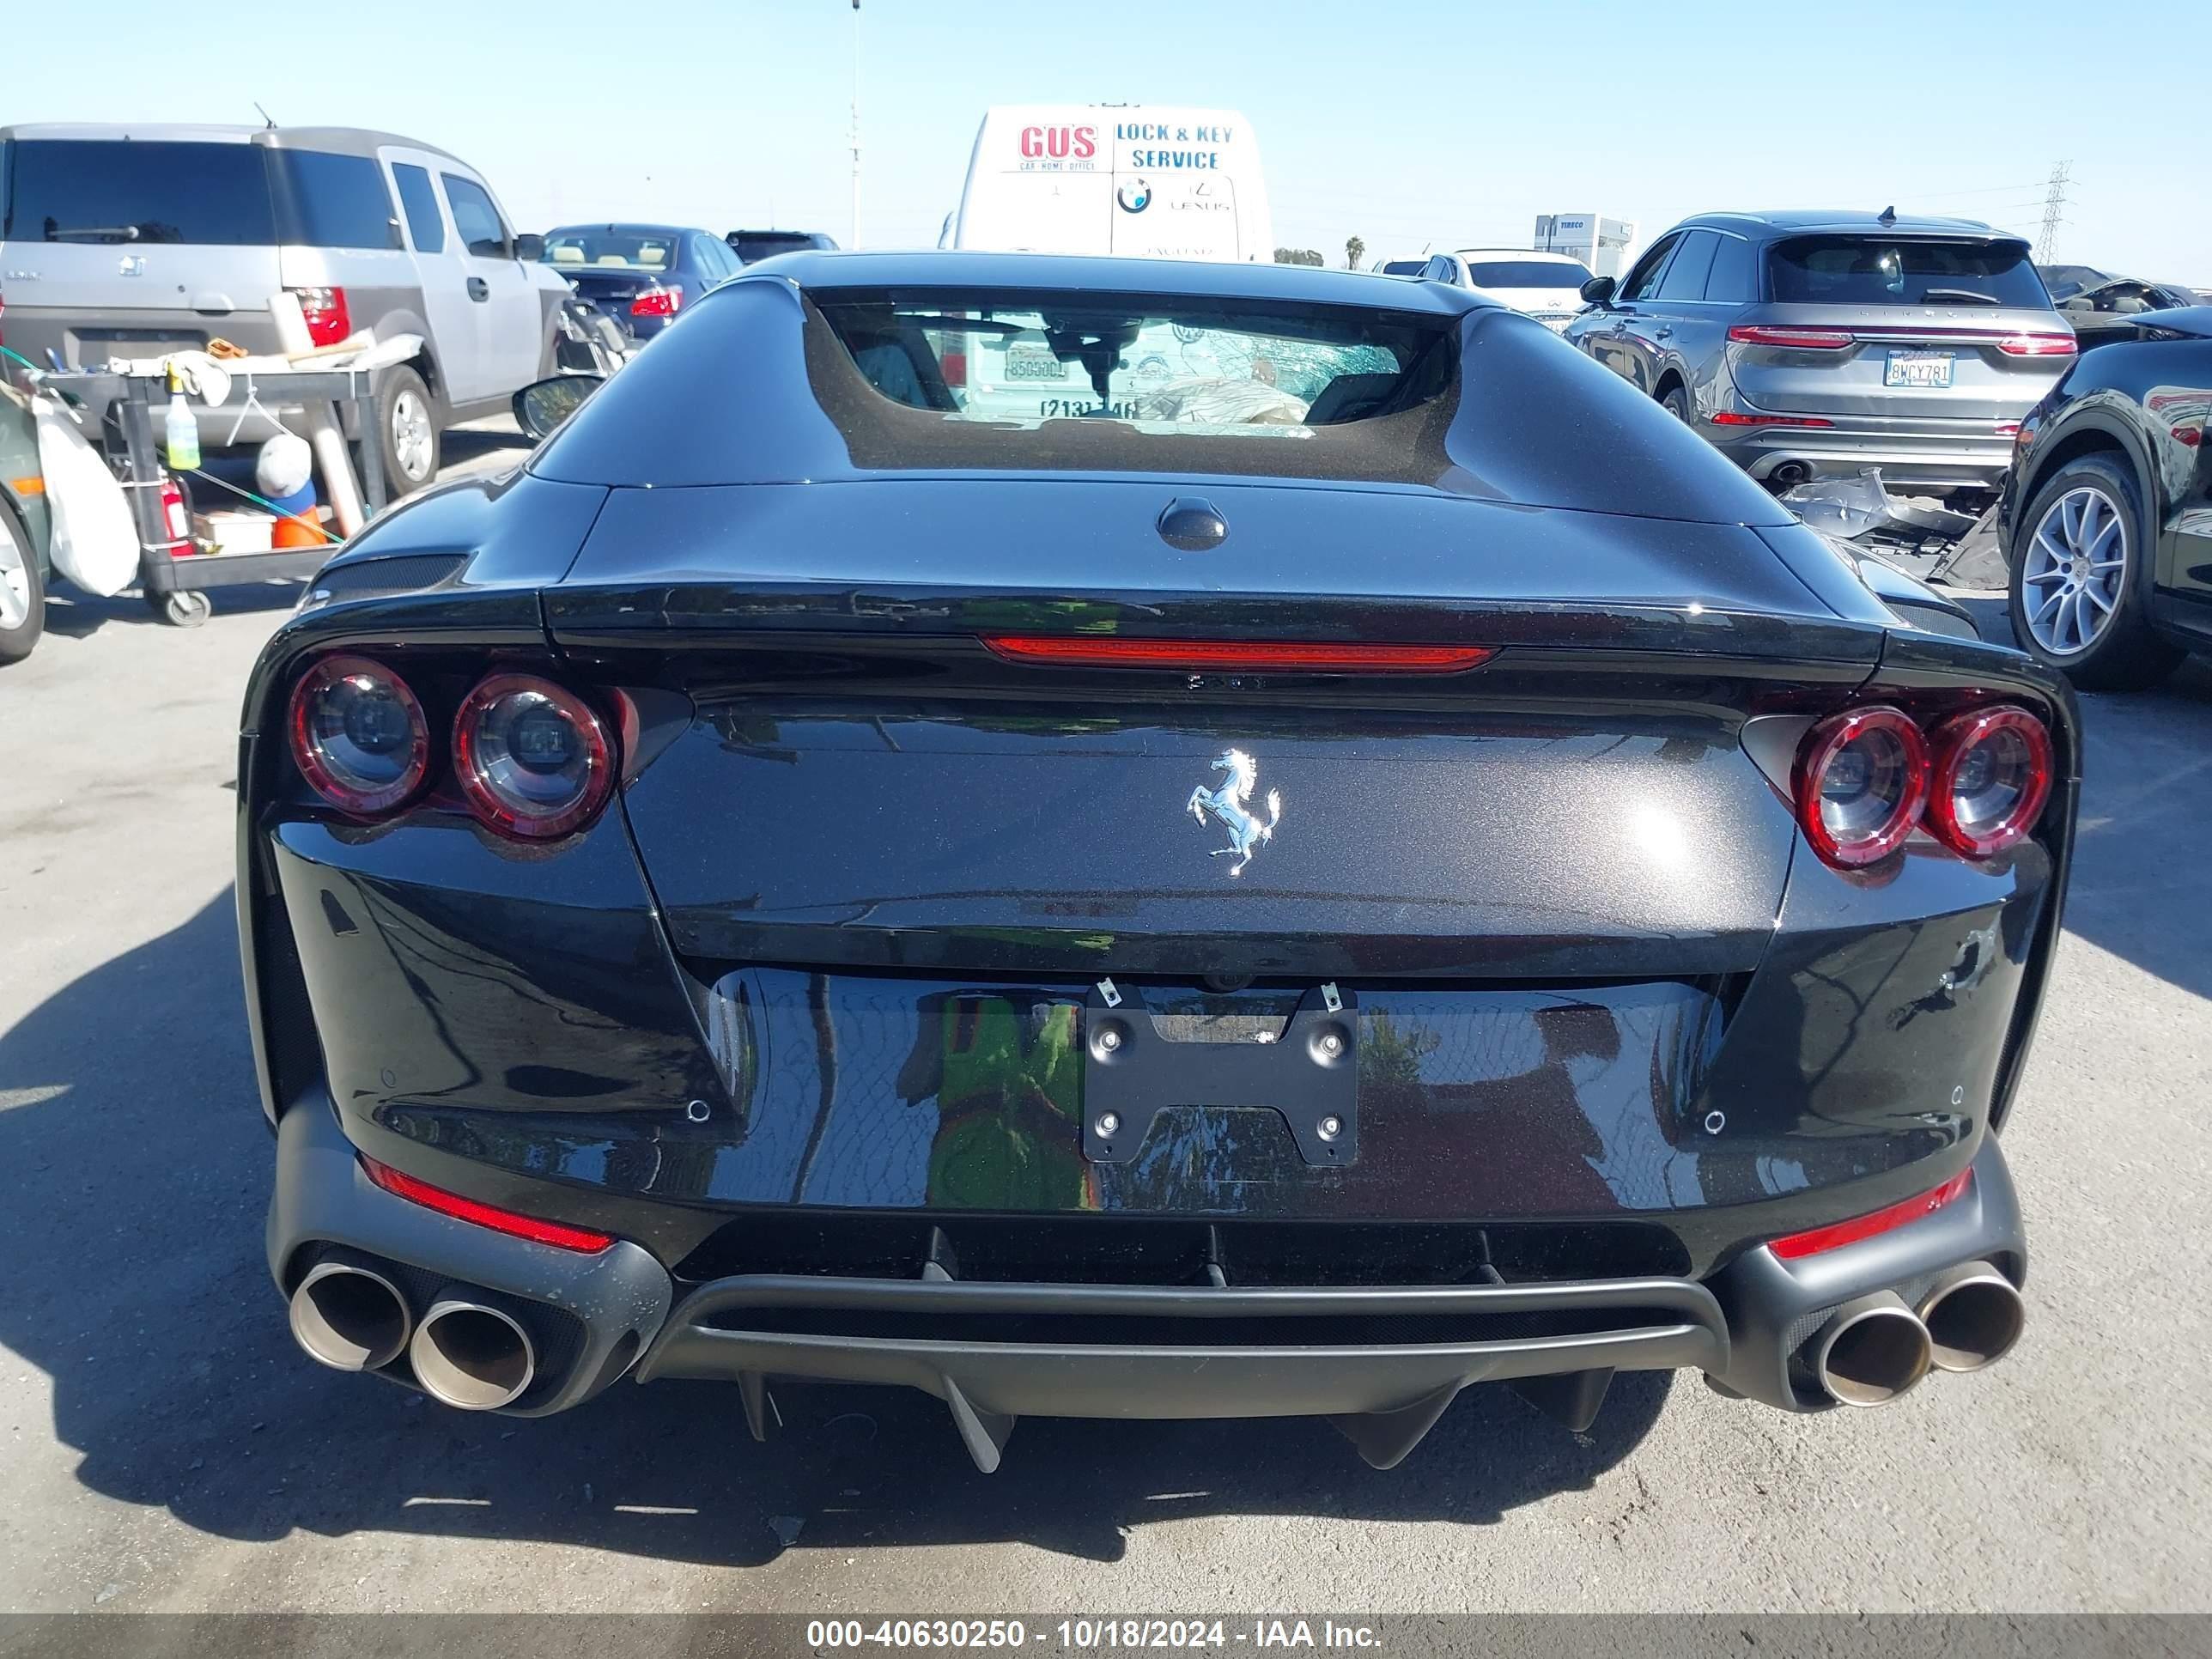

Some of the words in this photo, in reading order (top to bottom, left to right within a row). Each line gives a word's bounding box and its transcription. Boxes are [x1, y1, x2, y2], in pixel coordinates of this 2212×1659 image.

[1021, 126, 1096, 158] GUS
[1117, 123, 1169, 141] LOCK
[1176, 127, 1188, 142] &
[1196, 125, 1232, 143] KEY
[1132, 149, 1219, 170] SERVICE
[1170, 201, 1231, 211] LEXUS
[1892, 363, 1948, 380] 8WCY781
